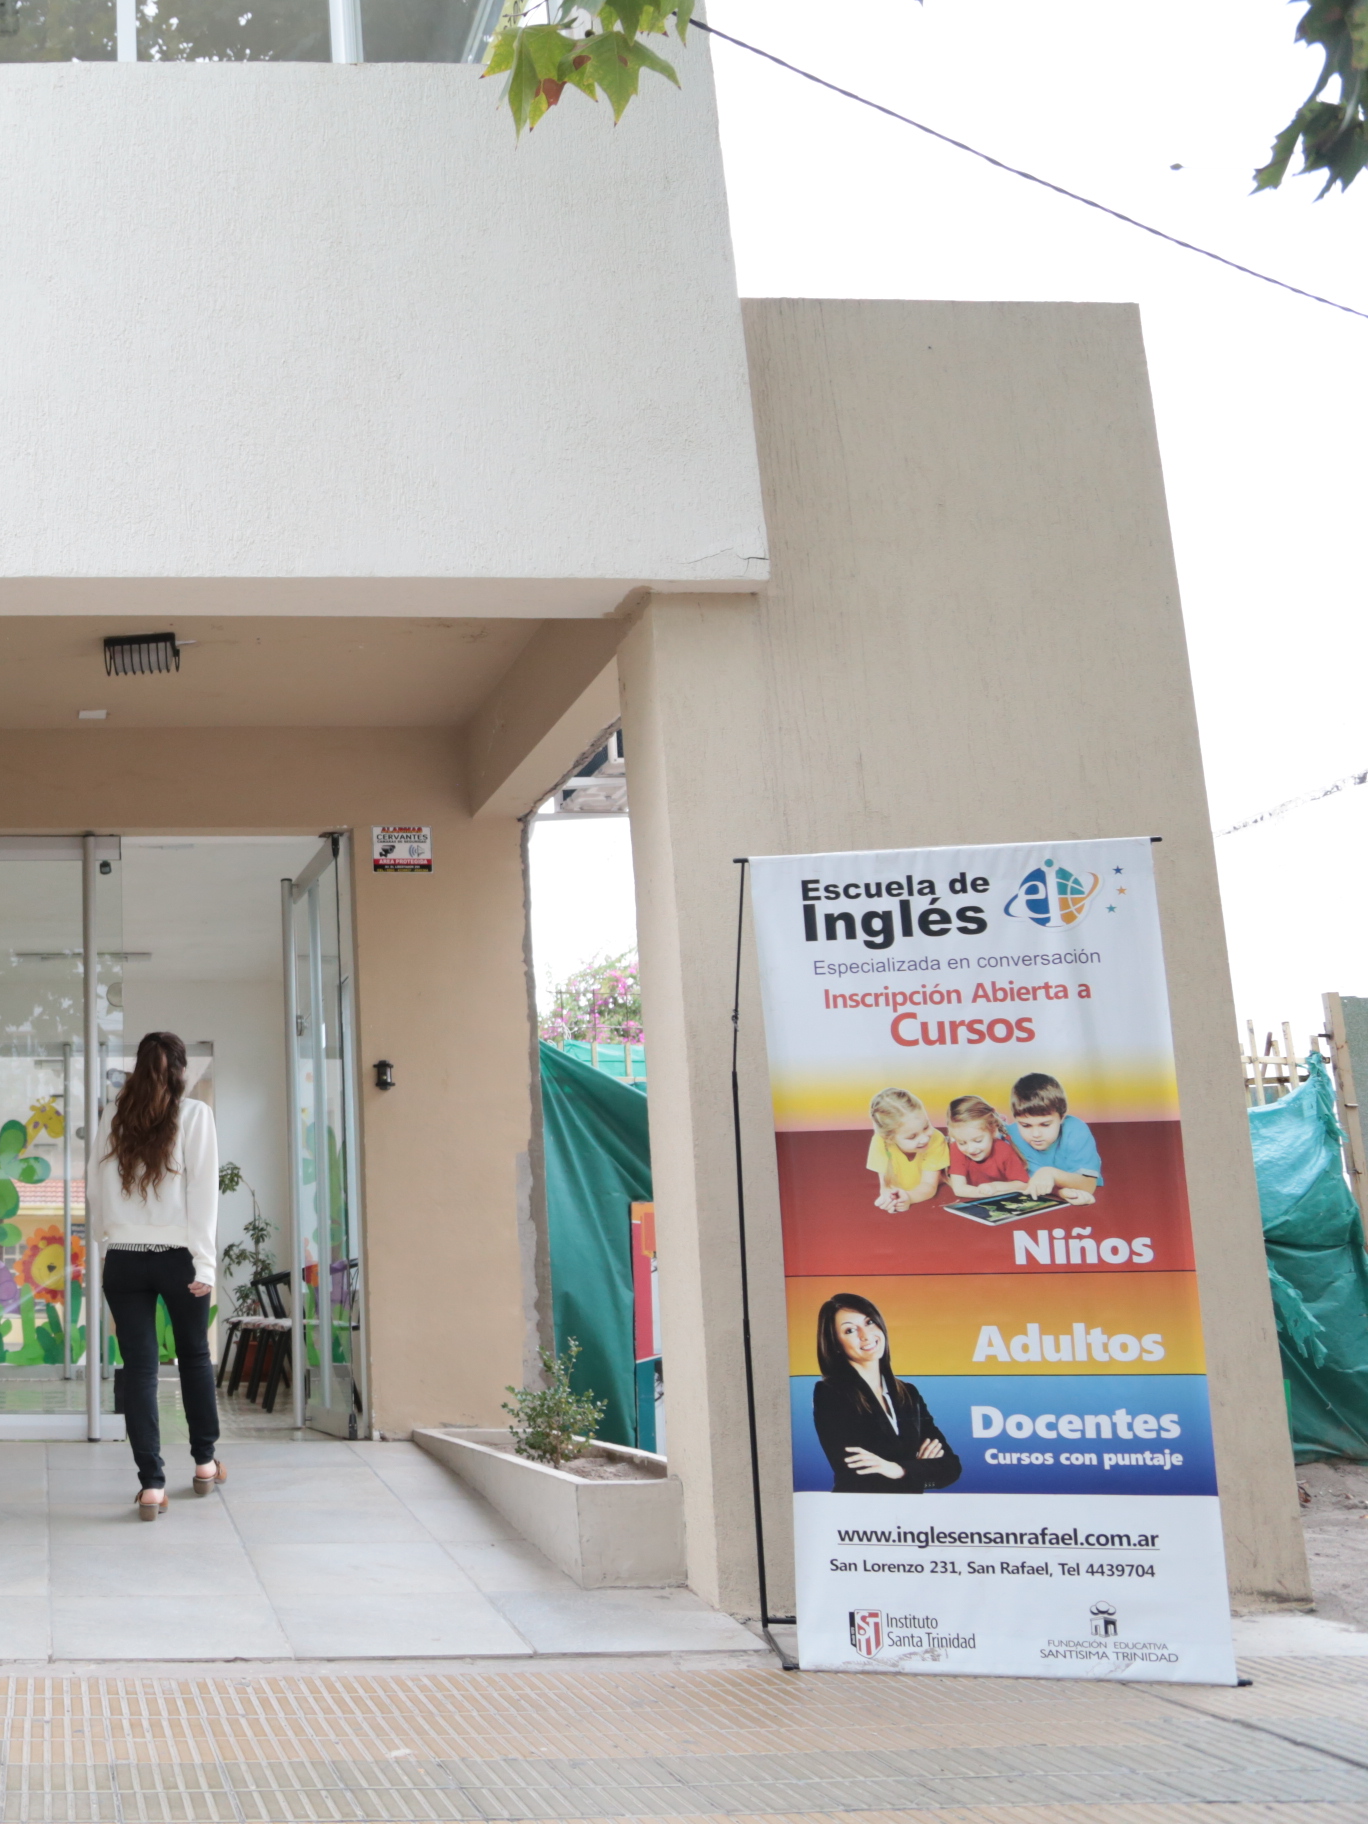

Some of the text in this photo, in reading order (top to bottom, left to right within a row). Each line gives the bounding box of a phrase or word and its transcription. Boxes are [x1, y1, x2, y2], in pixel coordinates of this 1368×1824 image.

[801, 872, 990, 902] Escuela de
[803, 897, 988, 950] Inglés
[813, 949, 1101, 978] Especializada en conversación
[823, 980, 1092, 1011] Inscripción Abierta a
[890, 1012, 1036, 1047] Cursos
[1013, 1227, 1154, 1265] Niños
[972, 1322, 1165, 1362] Adultos
[970, 1405, 1182, 1440] Docentes
[984, 1448, 1184, 1470] Cursos con puntaje
[837, 1525, 1160, 1550] www.inglesensanrafael.com.ar
[830, 1558, 1156, 1577] San Lorenzo 231, San Rafael, Tel 4439704
[886, 1612, 938, 1629] Instituto
[887, 1631, 976, 1649] Santa Trinidad
[1047, 1639, 1169, 1650] FUNDACIÓN EDUCATIVA
[1039, 1647, 1179, 1663] SANTÍSIMA TRINIDAD
